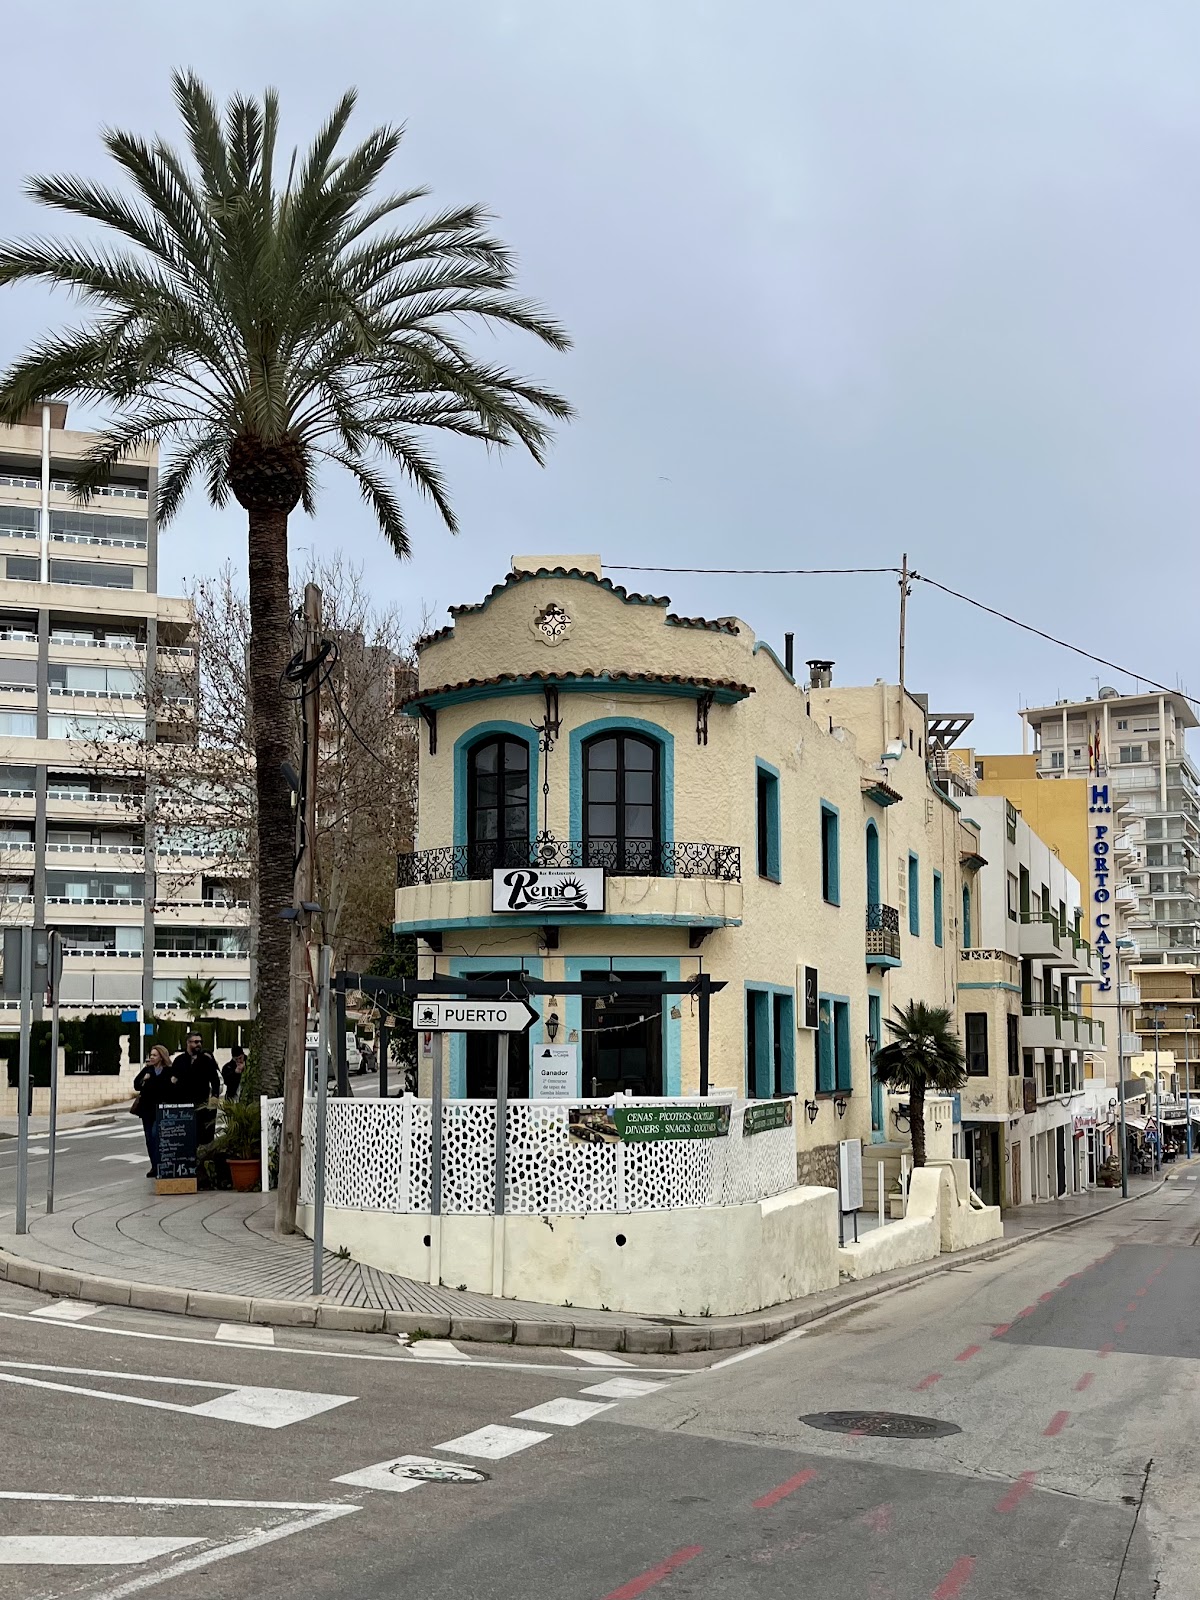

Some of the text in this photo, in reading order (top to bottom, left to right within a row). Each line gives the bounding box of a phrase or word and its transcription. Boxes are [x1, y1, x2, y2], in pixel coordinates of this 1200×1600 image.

[1092, 785, 1108, 804] H
[503, 869, 588, 910] Remo
[1094, 826, 1112, 991] PORTO CALPE
[445, 1009, 508, 1022] PUERTO
[627, 1112, 653, 1123] CENAS
[625, 1124, 660, 1135] DINNERS
[664, 1123, 691, 1133] SNACKS
